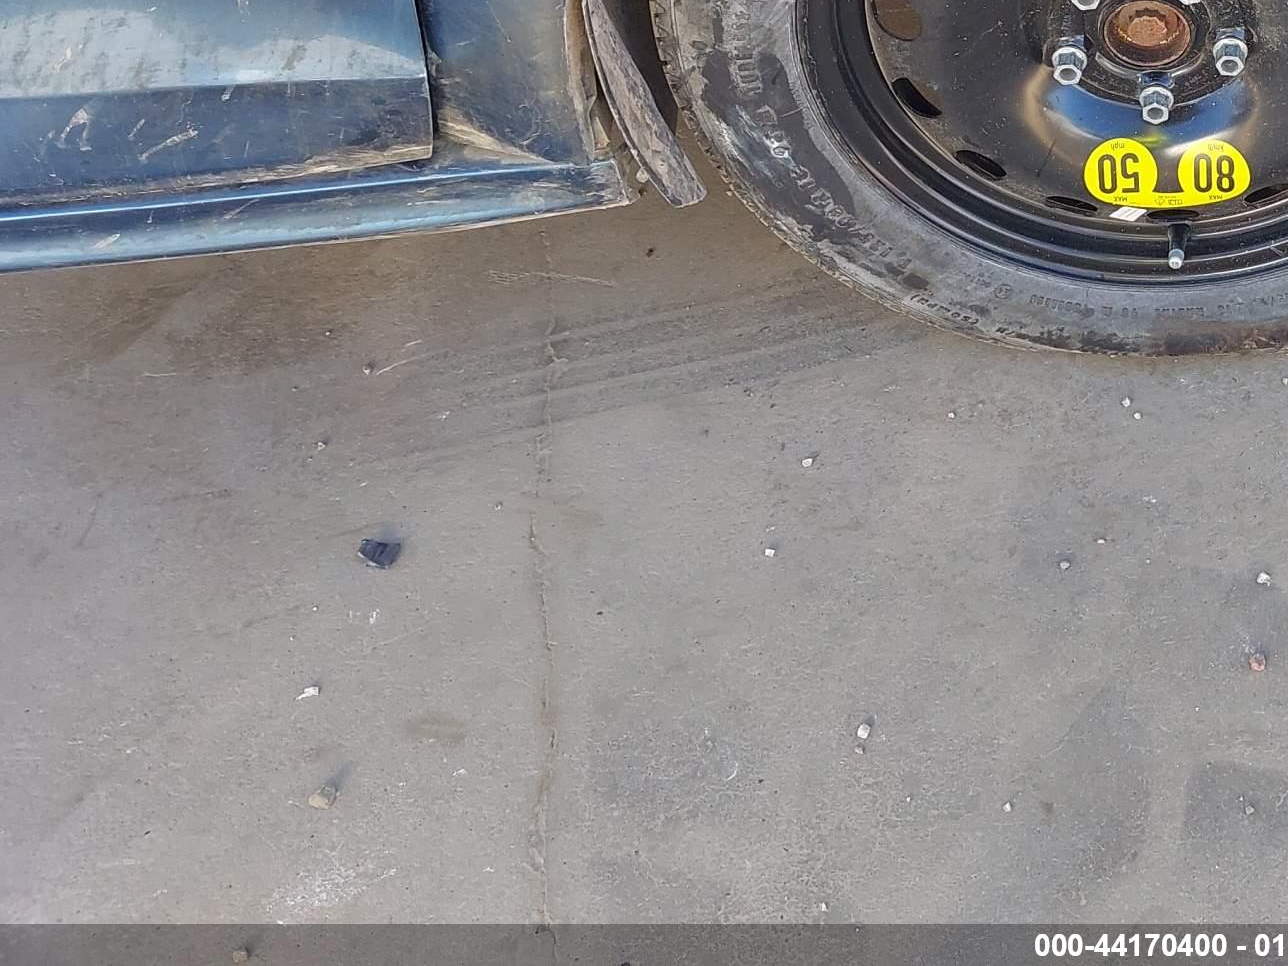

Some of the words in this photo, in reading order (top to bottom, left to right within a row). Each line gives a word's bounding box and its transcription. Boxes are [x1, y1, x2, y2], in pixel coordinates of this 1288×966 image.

[1110, 141, 1126, 151] mph
[1098, 153, 1140, 194] 50
[1193, 153, 1235, 194] 80
[1112, 195, 1128, 203] MAX
[1208, 194, 1223, 202] MAX
